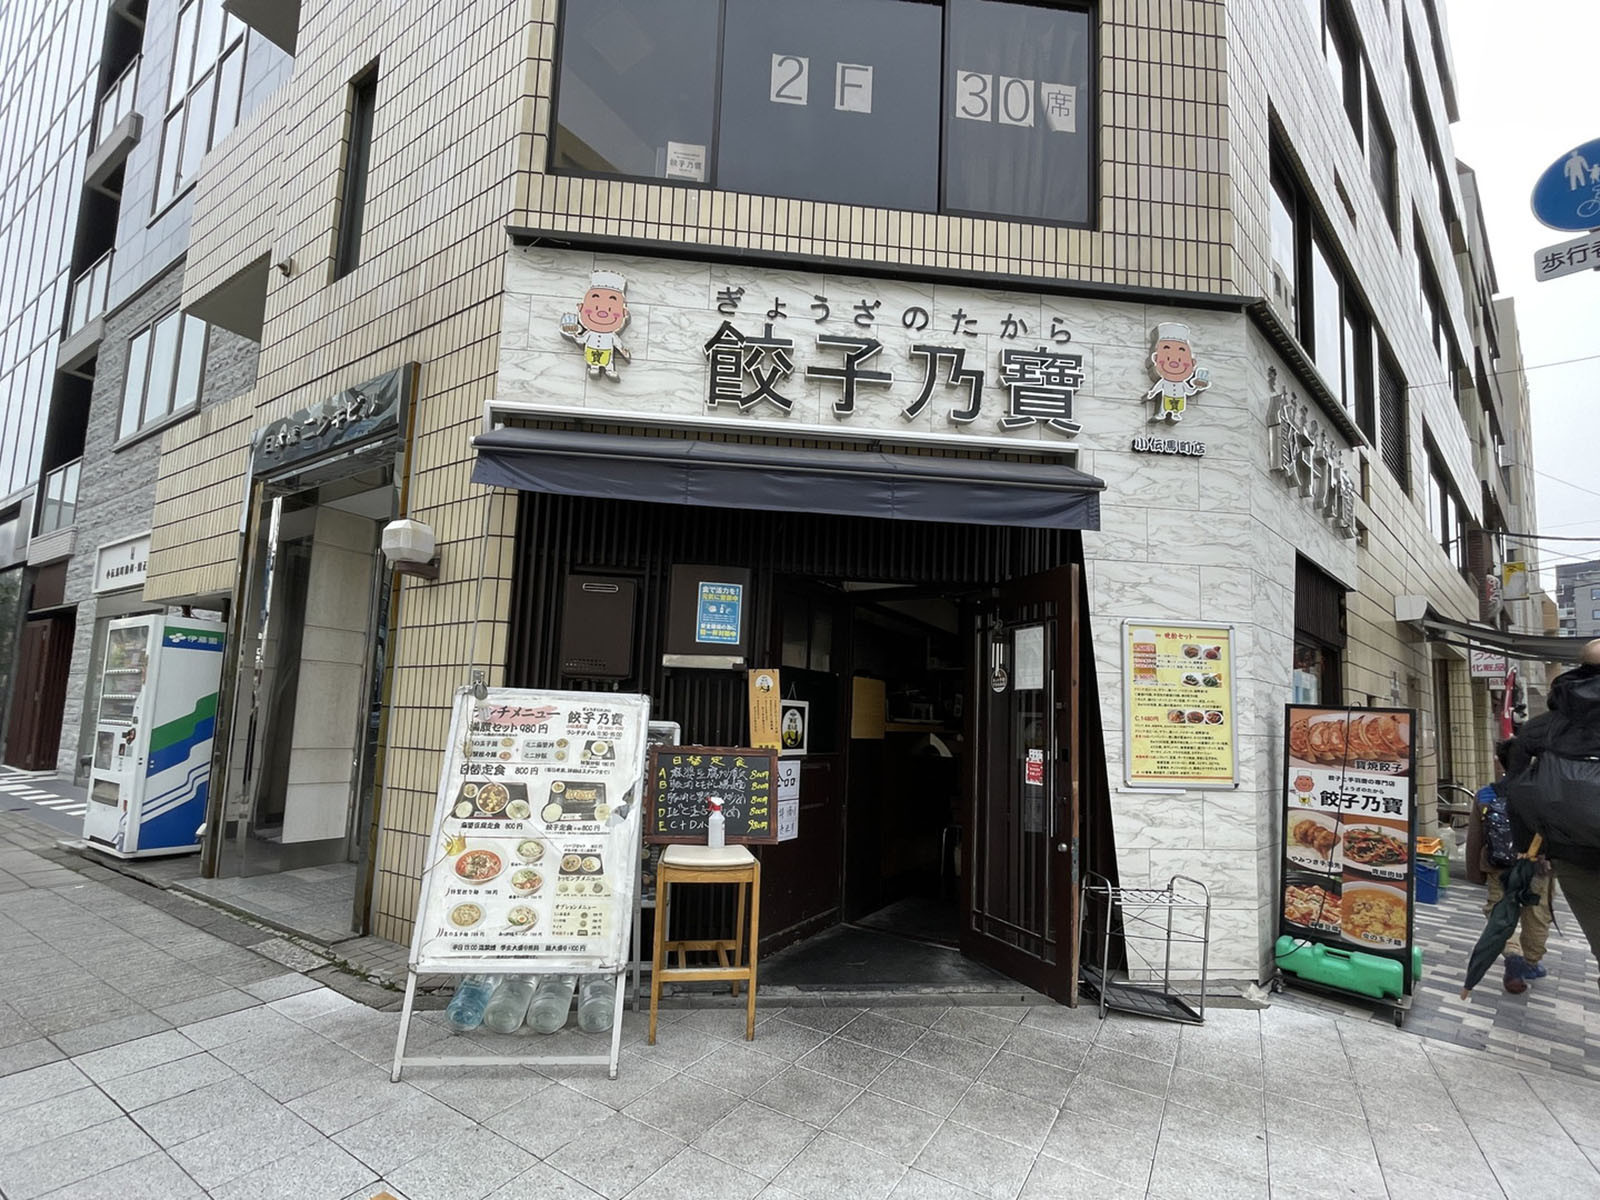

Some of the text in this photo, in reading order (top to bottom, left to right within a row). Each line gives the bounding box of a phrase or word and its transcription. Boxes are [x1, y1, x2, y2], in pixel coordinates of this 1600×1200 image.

[716, 286, 1072, 345] ぎょうざのたから
[1131, 436, 1206, 457] 小伝馬町店
[519, 724, 549, 734] 980円
[658, 767, 667, 779] A
[658, 780, 668, 790] B
[658, 794, 666, 803] C
[658, 808, 666, 818] D
[658, 821, 668, 832] E
